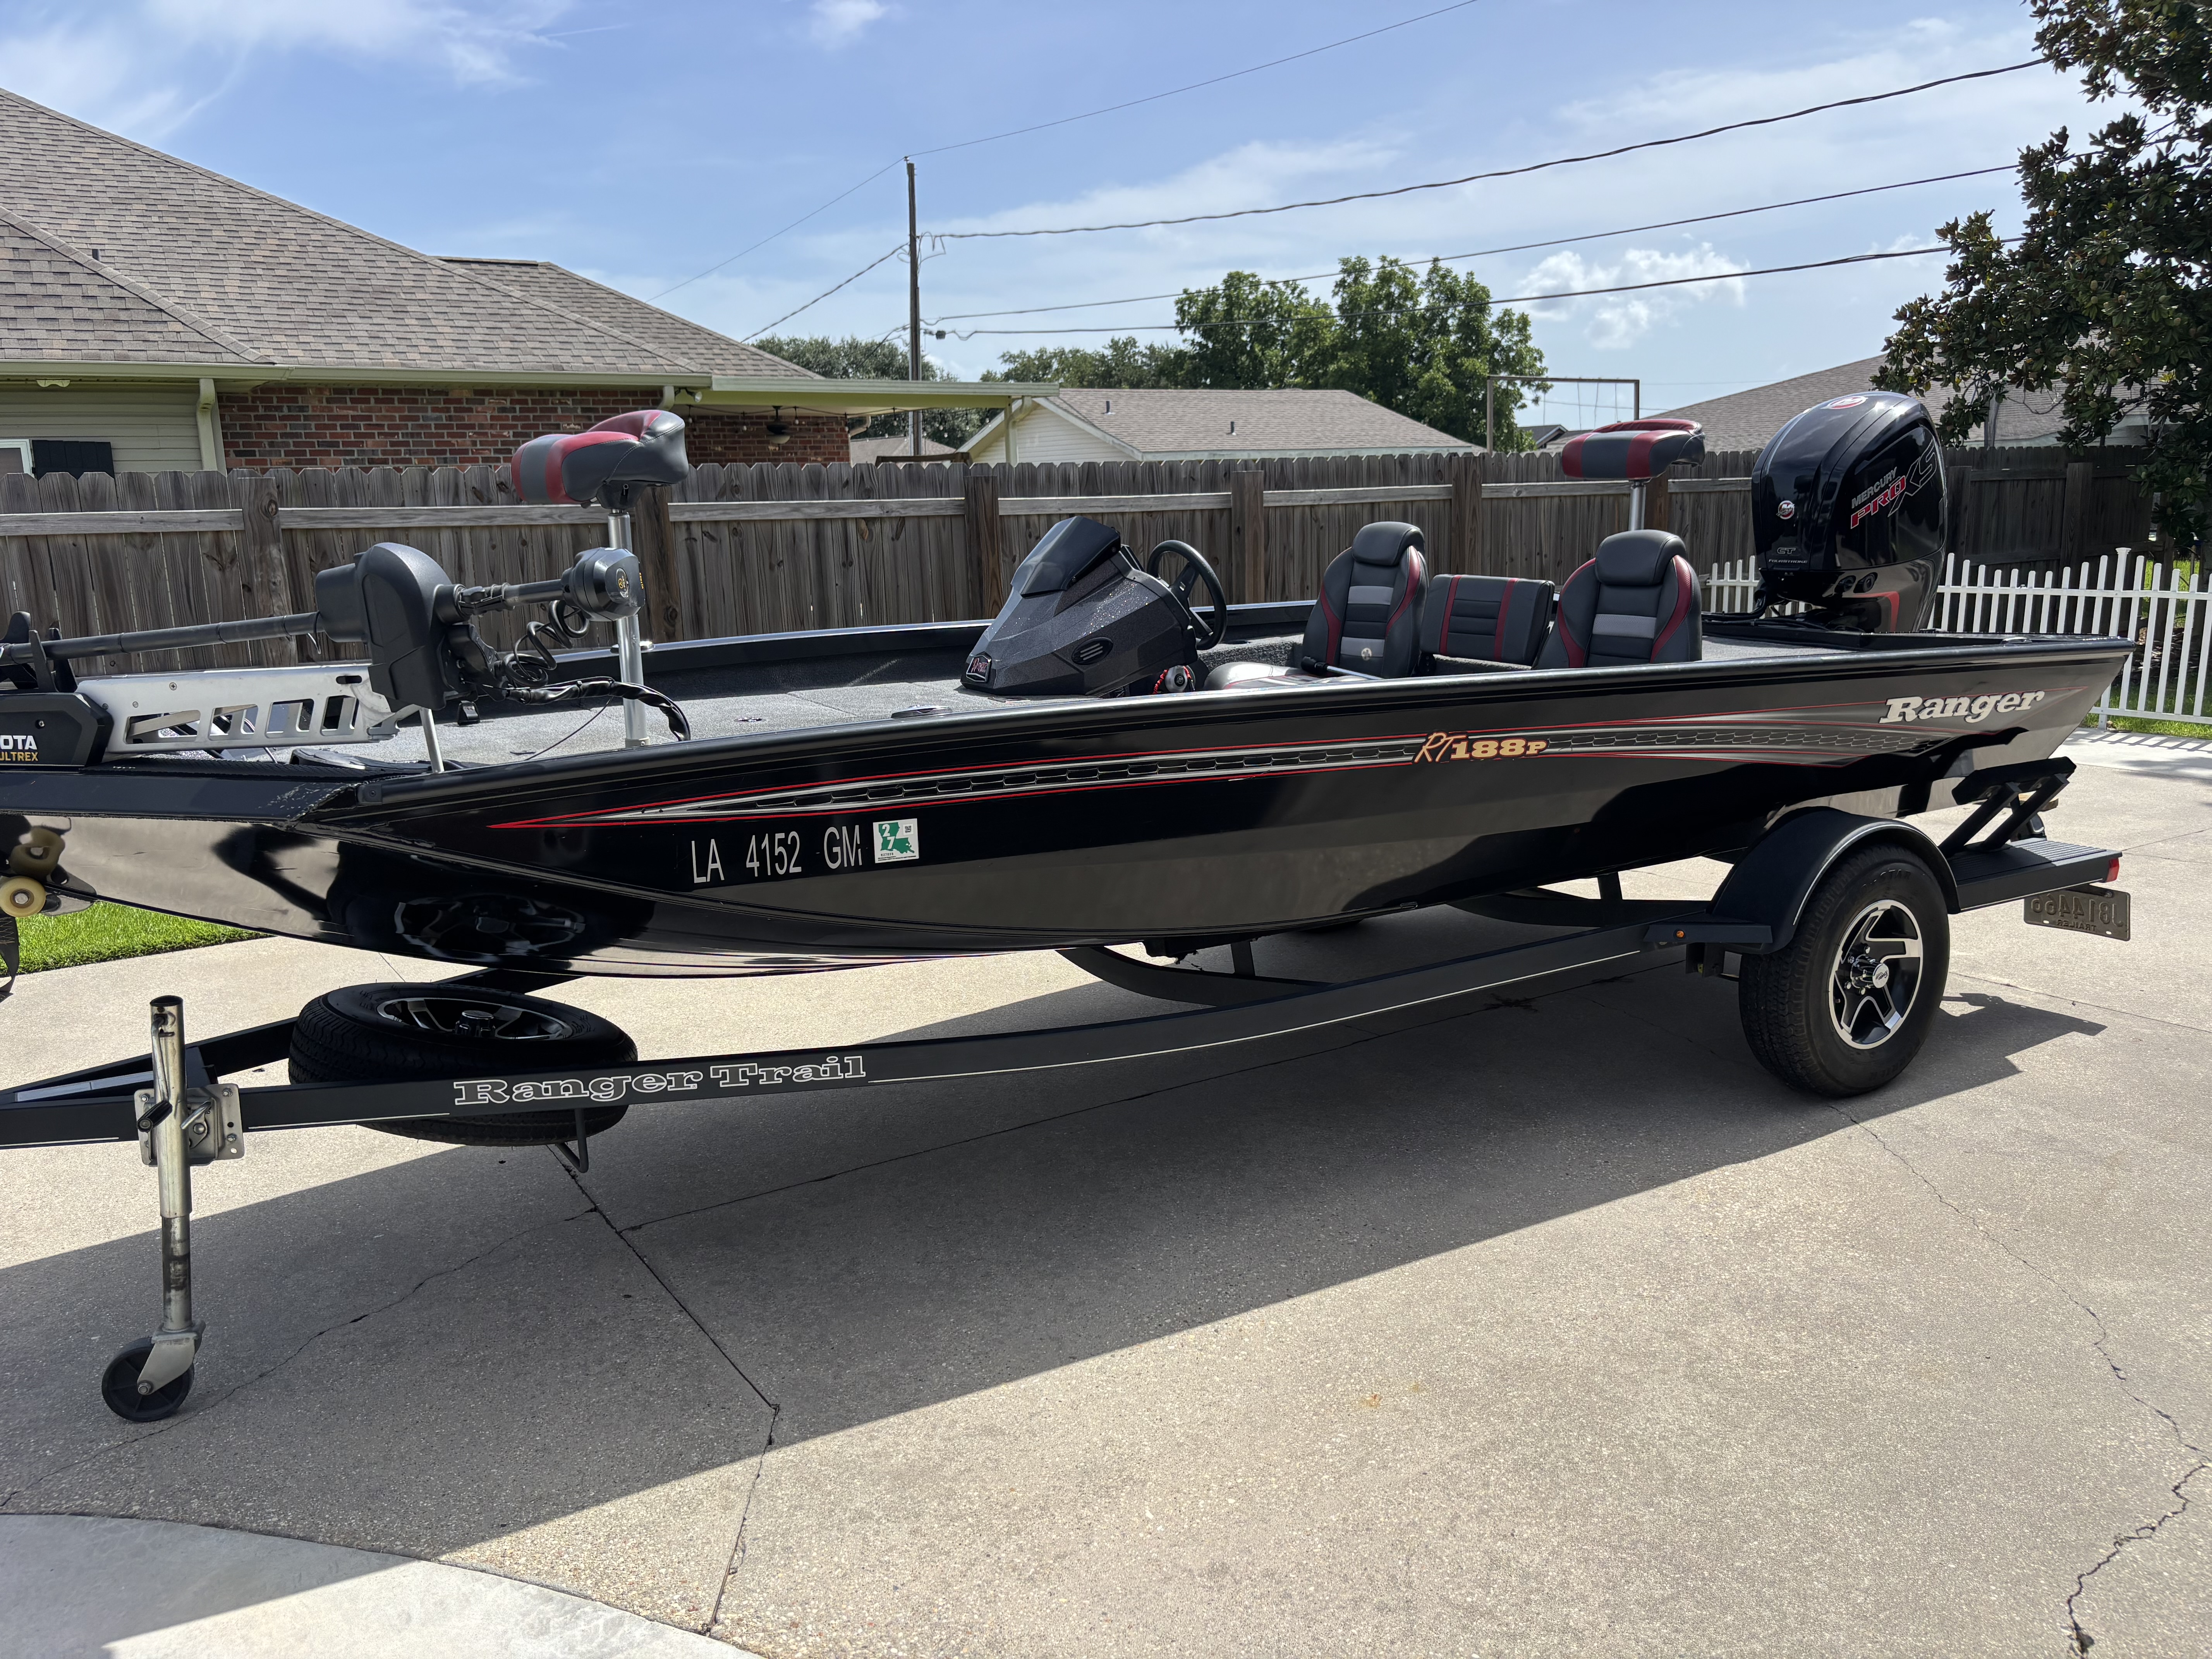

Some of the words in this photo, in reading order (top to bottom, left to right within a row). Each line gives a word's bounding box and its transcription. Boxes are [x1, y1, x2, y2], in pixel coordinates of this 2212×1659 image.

[1851, 475, 1906, 529] PRO
[1887, 438, 1937, 517] XS
[1851, 466, 1897, 509] MERCURY
[1879, 690, 2045, 724] Ranger
[691, 839, 725, 883] LA
[746, 831, 802, 877] 4152
[824, 825, 862, 869] GM
[453, 1071, 703, 1105] Ranger
[710, 1056, 866, 1087] Trail
